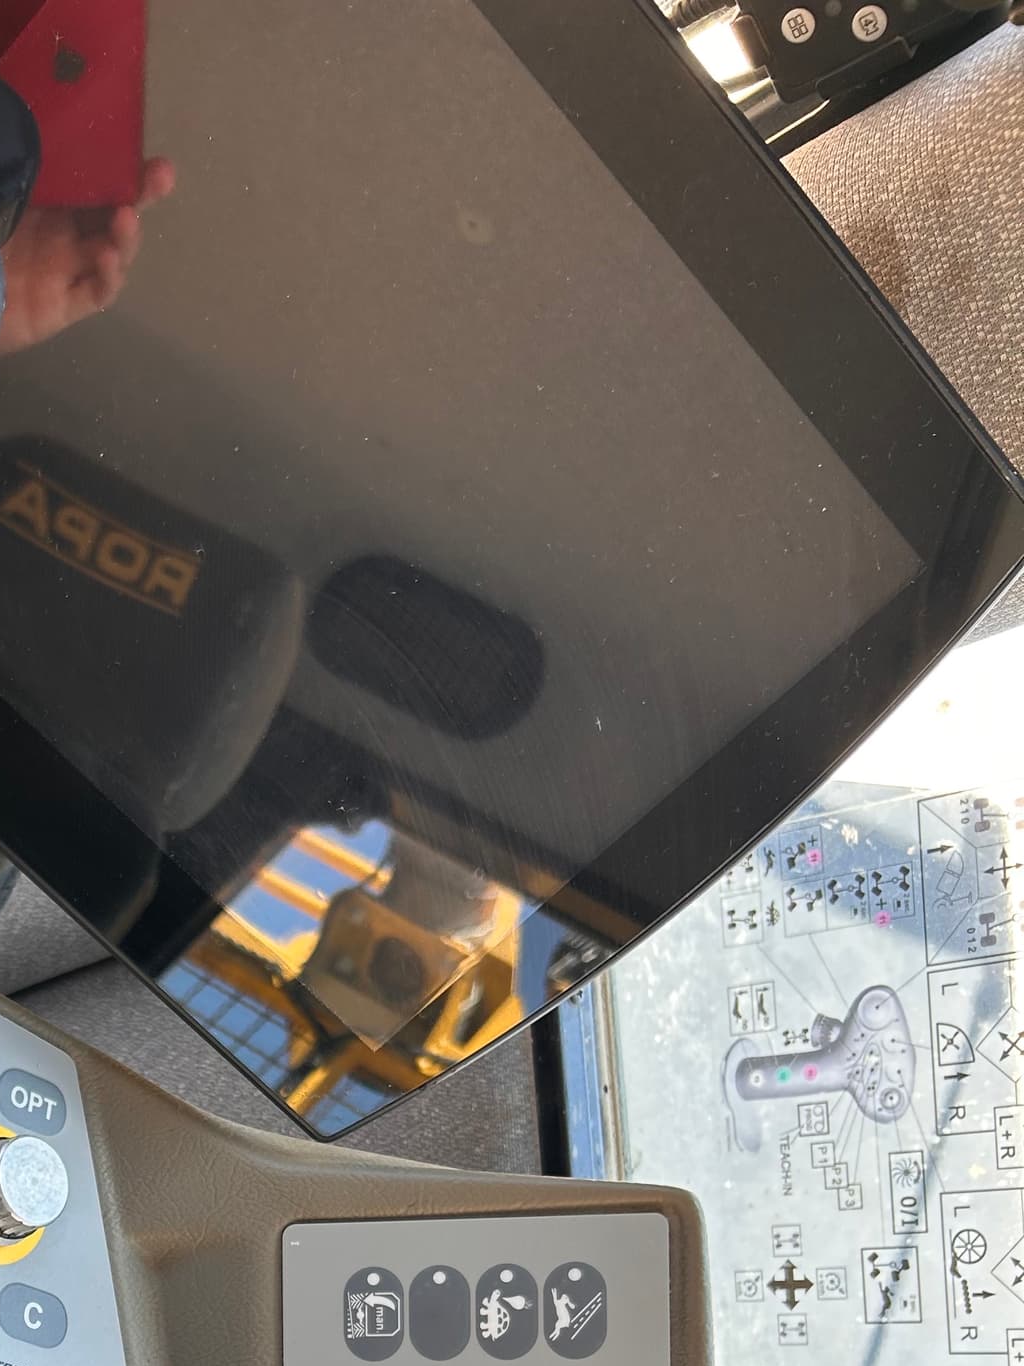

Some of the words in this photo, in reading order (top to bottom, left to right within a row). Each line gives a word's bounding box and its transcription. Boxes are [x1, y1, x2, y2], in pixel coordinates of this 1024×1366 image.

[941, 984, 958, 996] L
[10, 1086, 57, 1121] OPT
[948, 1106, 966, 1121] R
[999, 1115, 1014, 1126] L
[1000, 1145, 1016, 1160] R
[779, 1135, 792, 1197] TEACH-IN
[953, 1205, 971, 1218] L
[23, 1302, 43, 1330] C
[376, 1306, 384, 1334] man.
[961, 1326, 978, 1341] R
[1012, 1338, 1024, 1348] L
